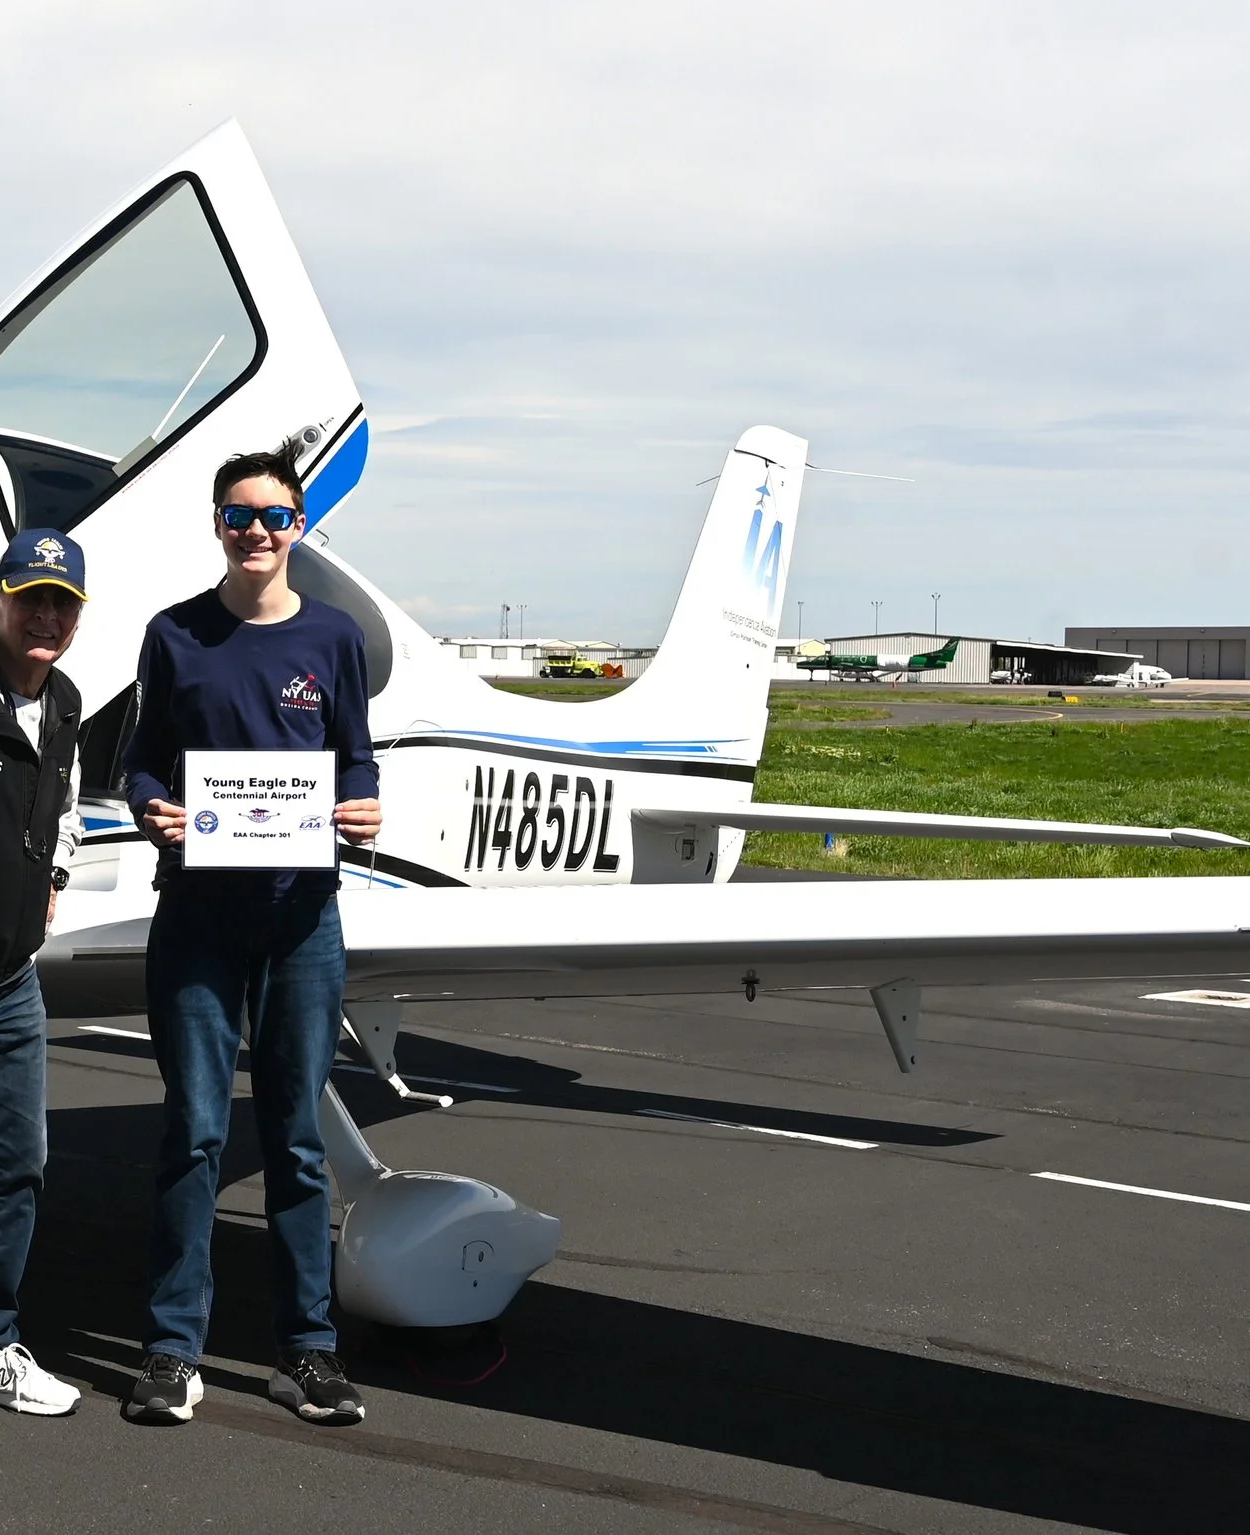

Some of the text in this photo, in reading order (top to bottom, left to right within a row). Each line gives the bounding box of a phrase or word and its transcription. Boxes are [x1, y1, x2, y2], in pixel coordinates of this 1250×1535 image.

[203, 777, 317, 790] Young Eagle Day
[213, 791, 307, 801] Centennial Airport
[464, 765, 620, 873] N485DL
